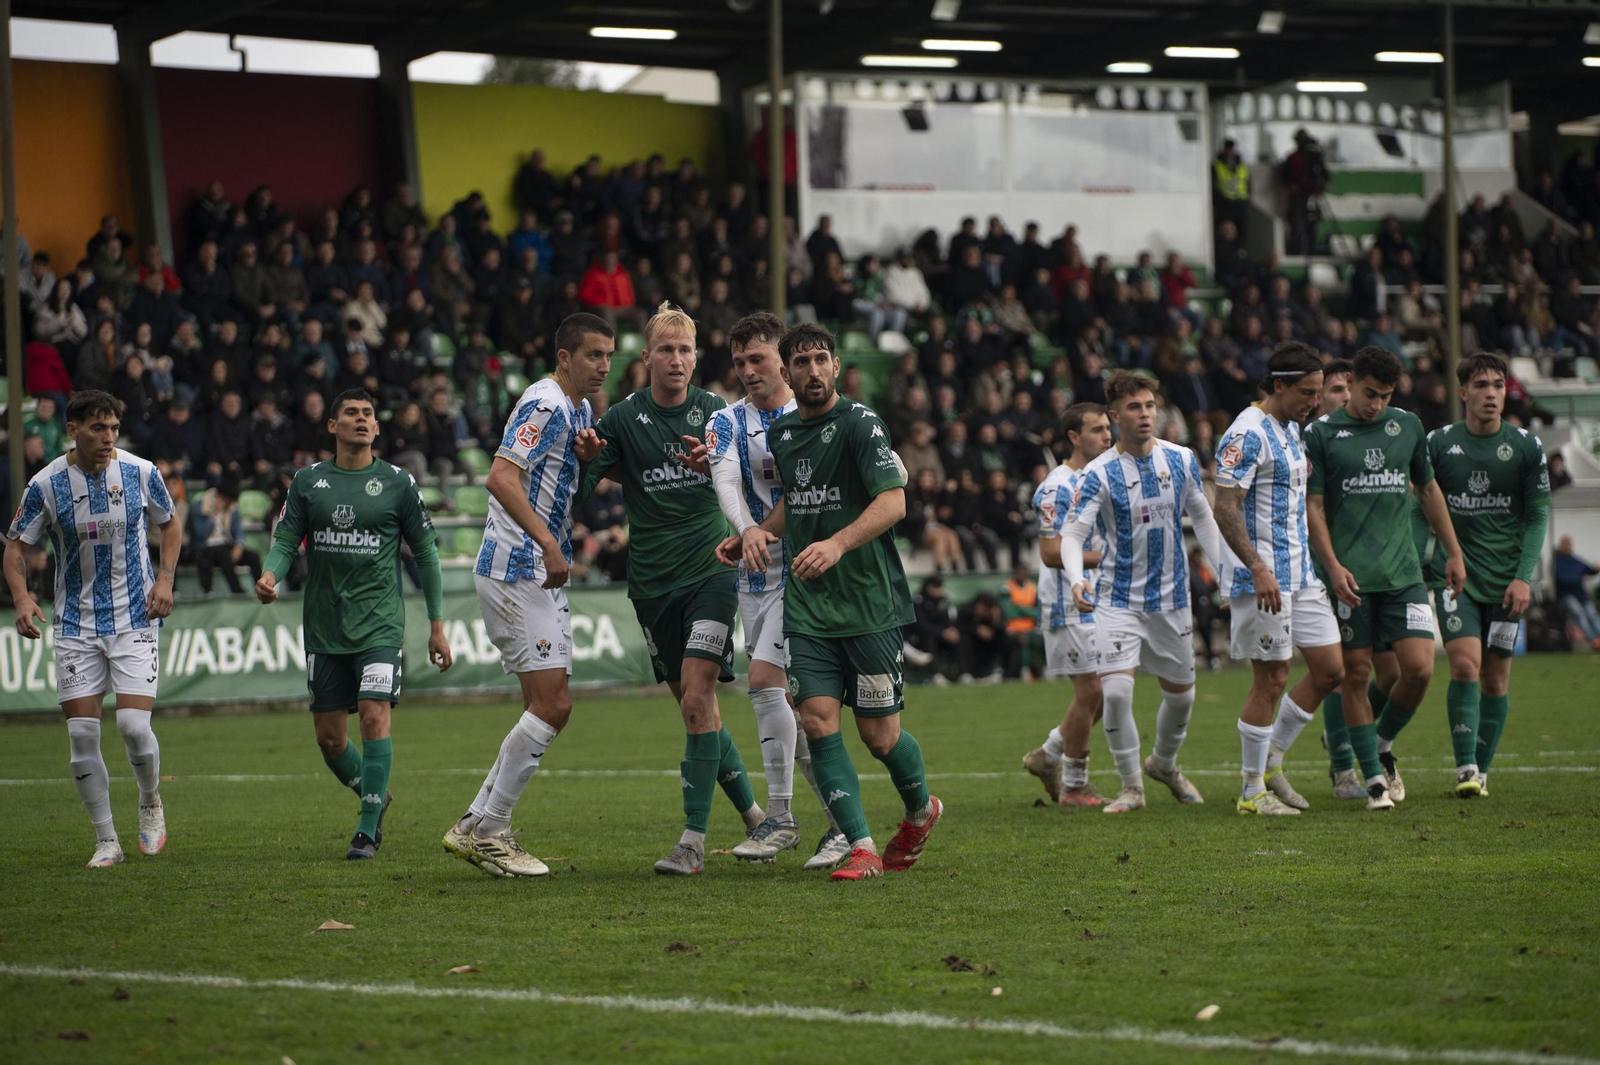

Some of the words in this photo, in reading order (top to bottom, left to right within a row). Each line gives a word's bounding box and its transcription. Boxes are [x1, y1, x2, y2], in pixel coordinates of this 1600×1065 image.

[97, 519, 126, 529] Cálida
[61, 674, 87, 687] GARCÍA
[859, 686, 893, 699] Barcala
